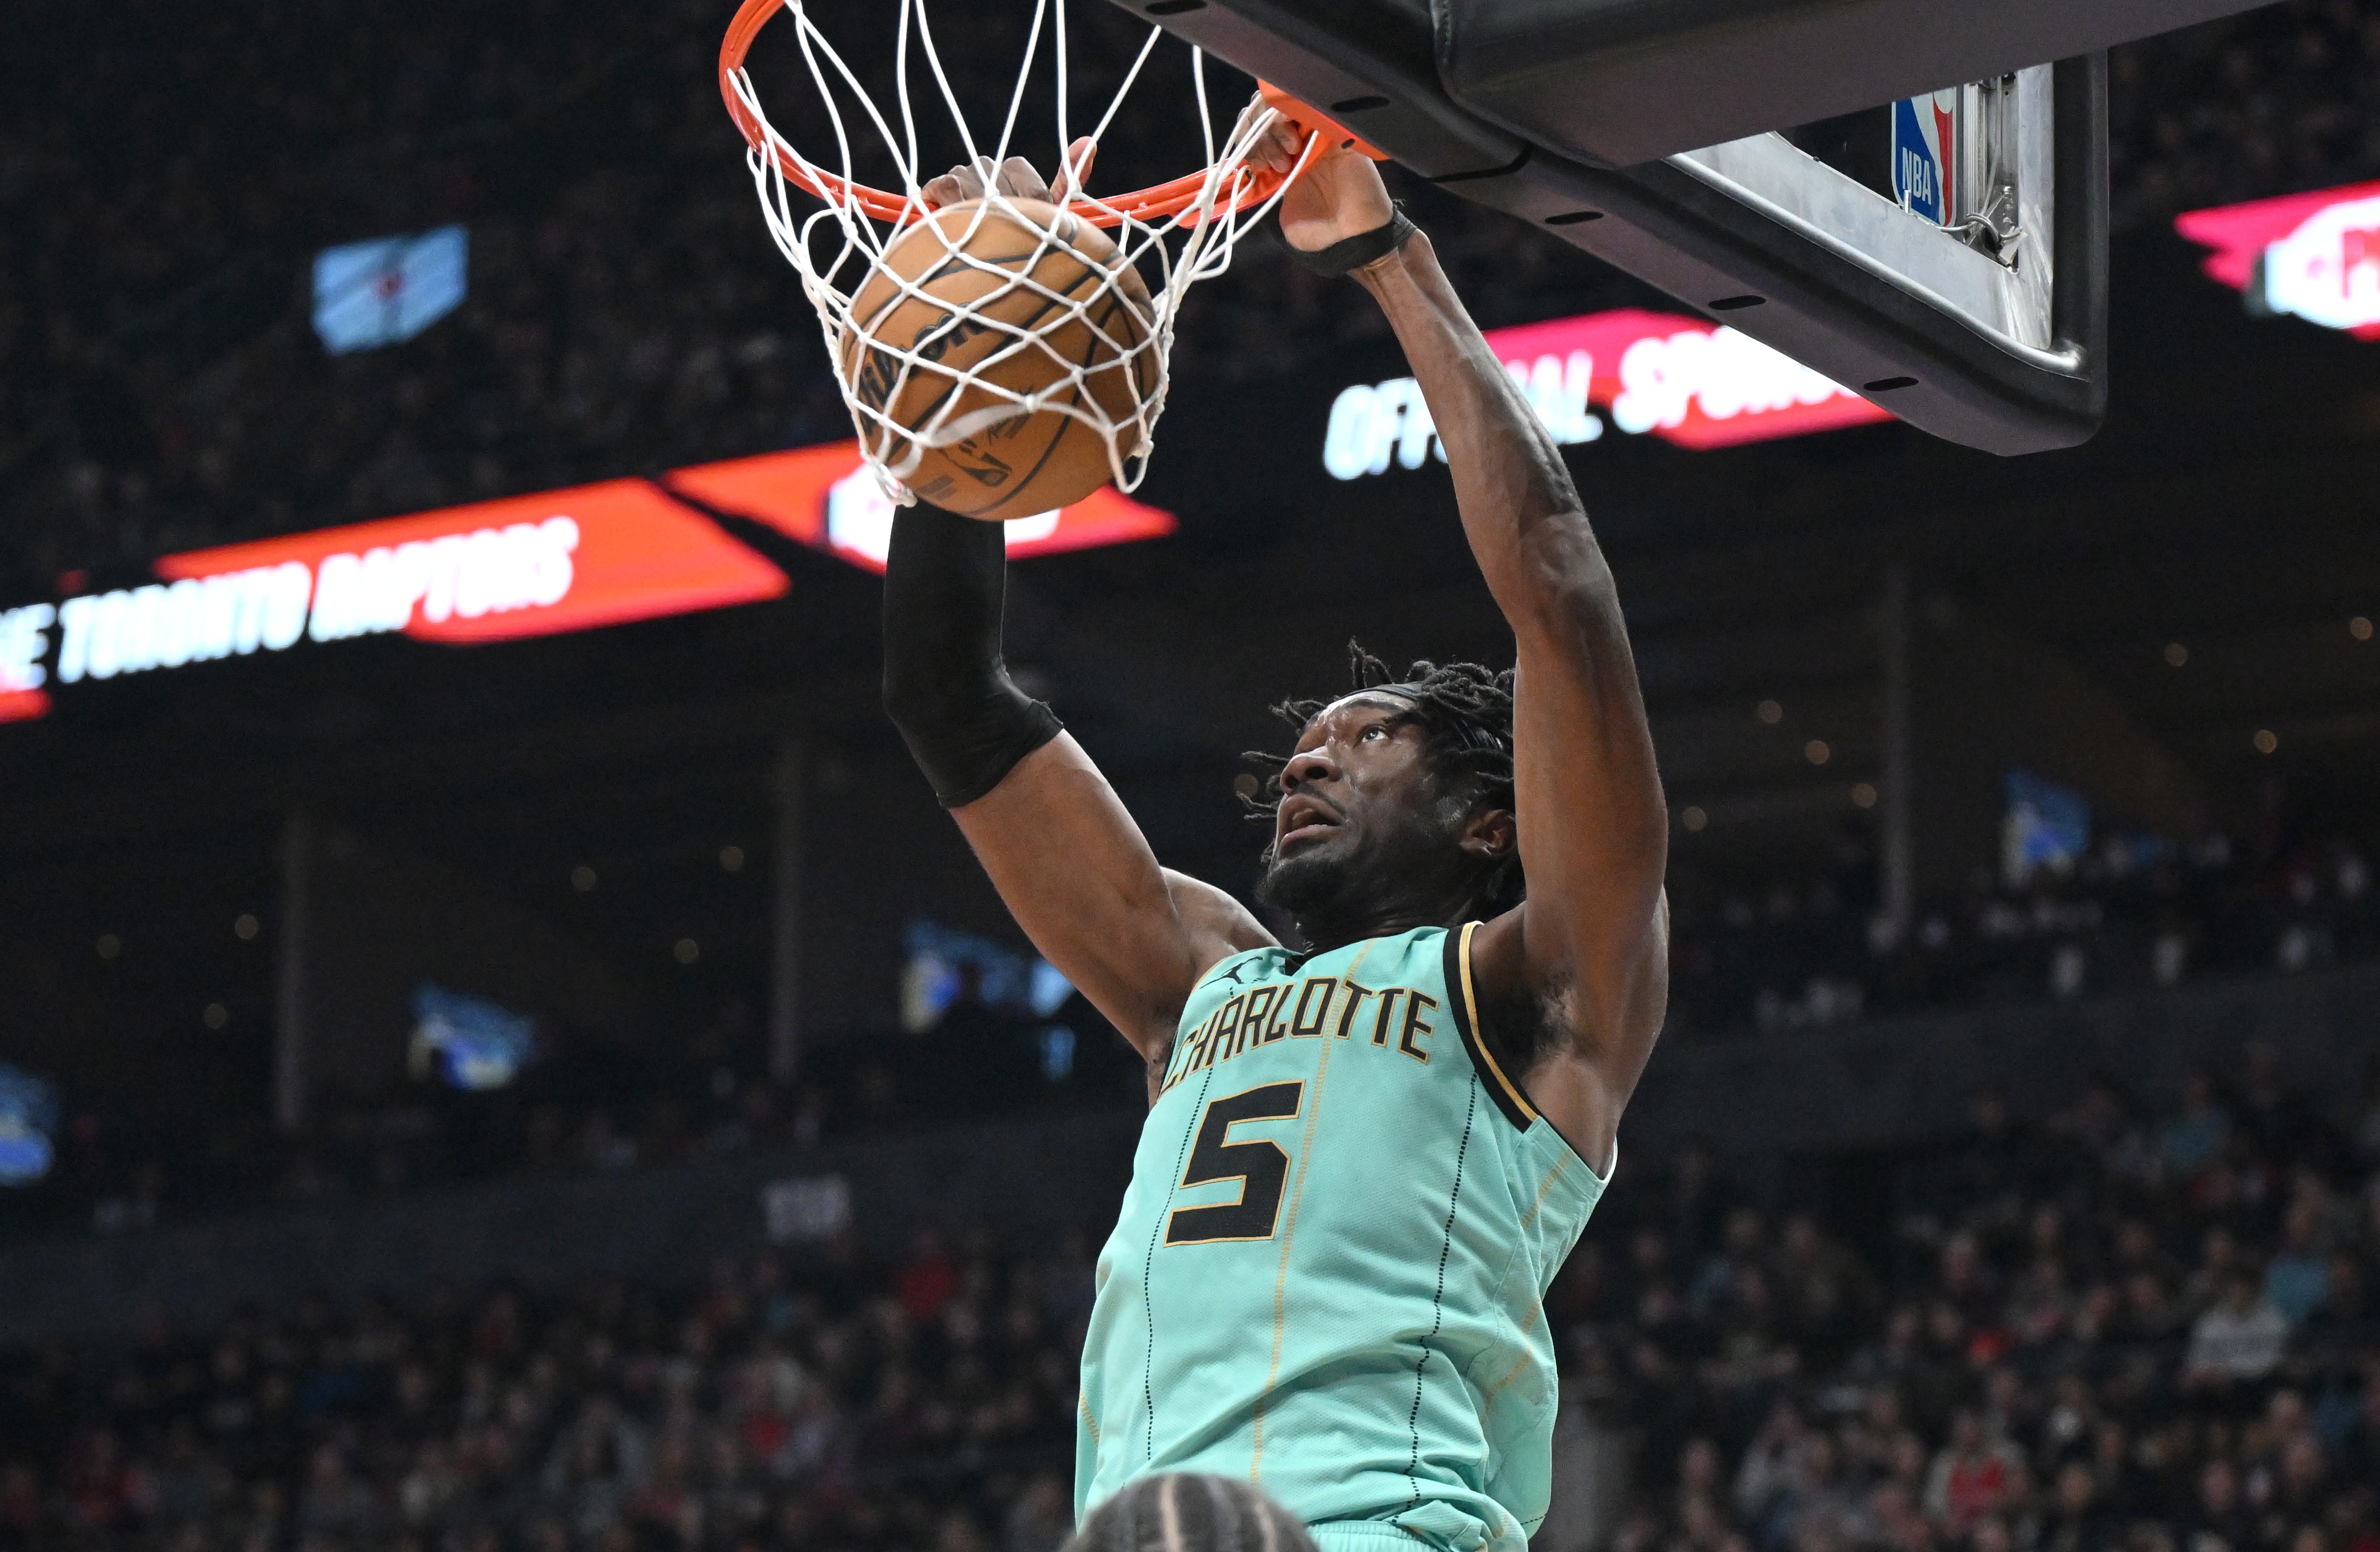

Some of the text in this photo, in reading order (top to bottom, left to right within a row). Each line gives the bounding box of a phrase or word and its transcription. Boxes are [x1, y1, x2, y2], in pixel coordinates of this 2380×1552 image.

[1901, 147, 1932, 206] NBA
[57, 562, 312, 684] TORONTO
[309, 516, 580, 643] RAPTORS
[1158, 976, 1440, 1099] CHARLOTTE
[1163, 1079, 1306, 1247] 5
